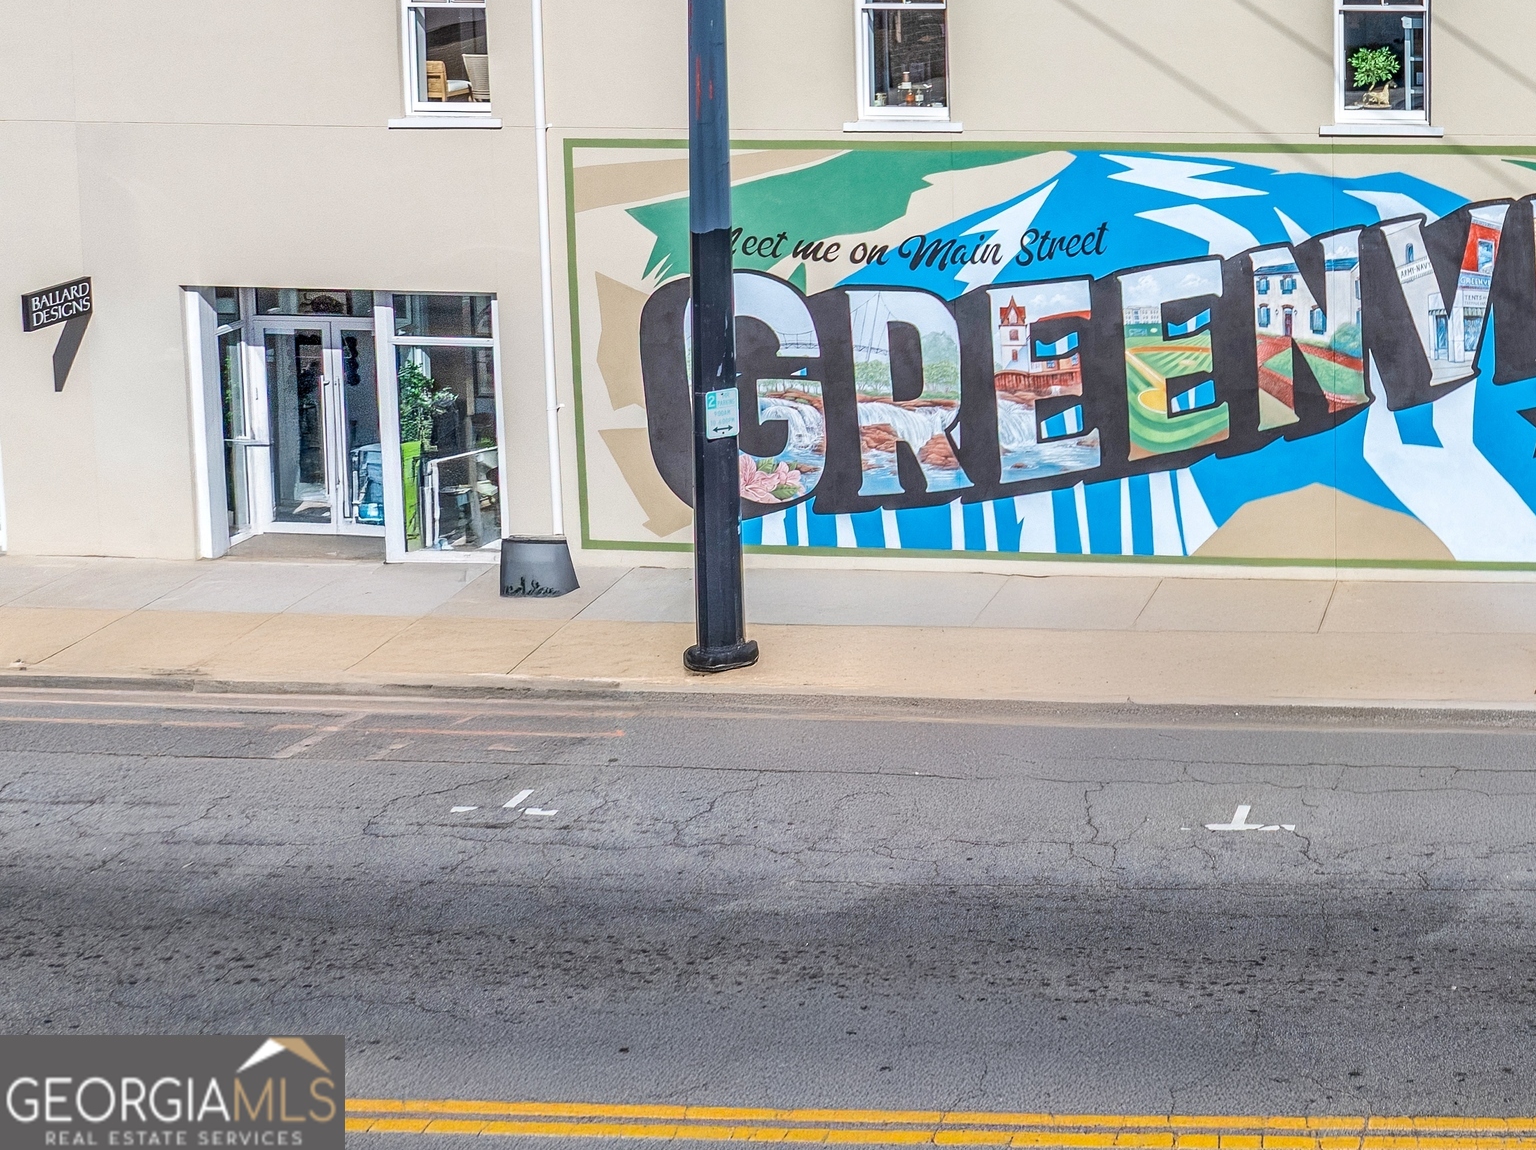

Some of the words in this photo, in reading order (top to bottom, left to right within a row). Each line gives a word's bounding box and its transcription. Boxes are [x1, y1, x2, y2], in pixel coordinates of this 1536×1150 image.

[731, 227, 789, 258] eet
[792, 234, 839, 263] me
[849, 241, 890, 266] on
[898, 234, 1003, 272] Main
[1015, 221, 1110, 267] Street
[31, 282, 90, 312] BALLARD
[32, 296, 91, 327] DESIGNS
[708, 395, 716, 407] 2
